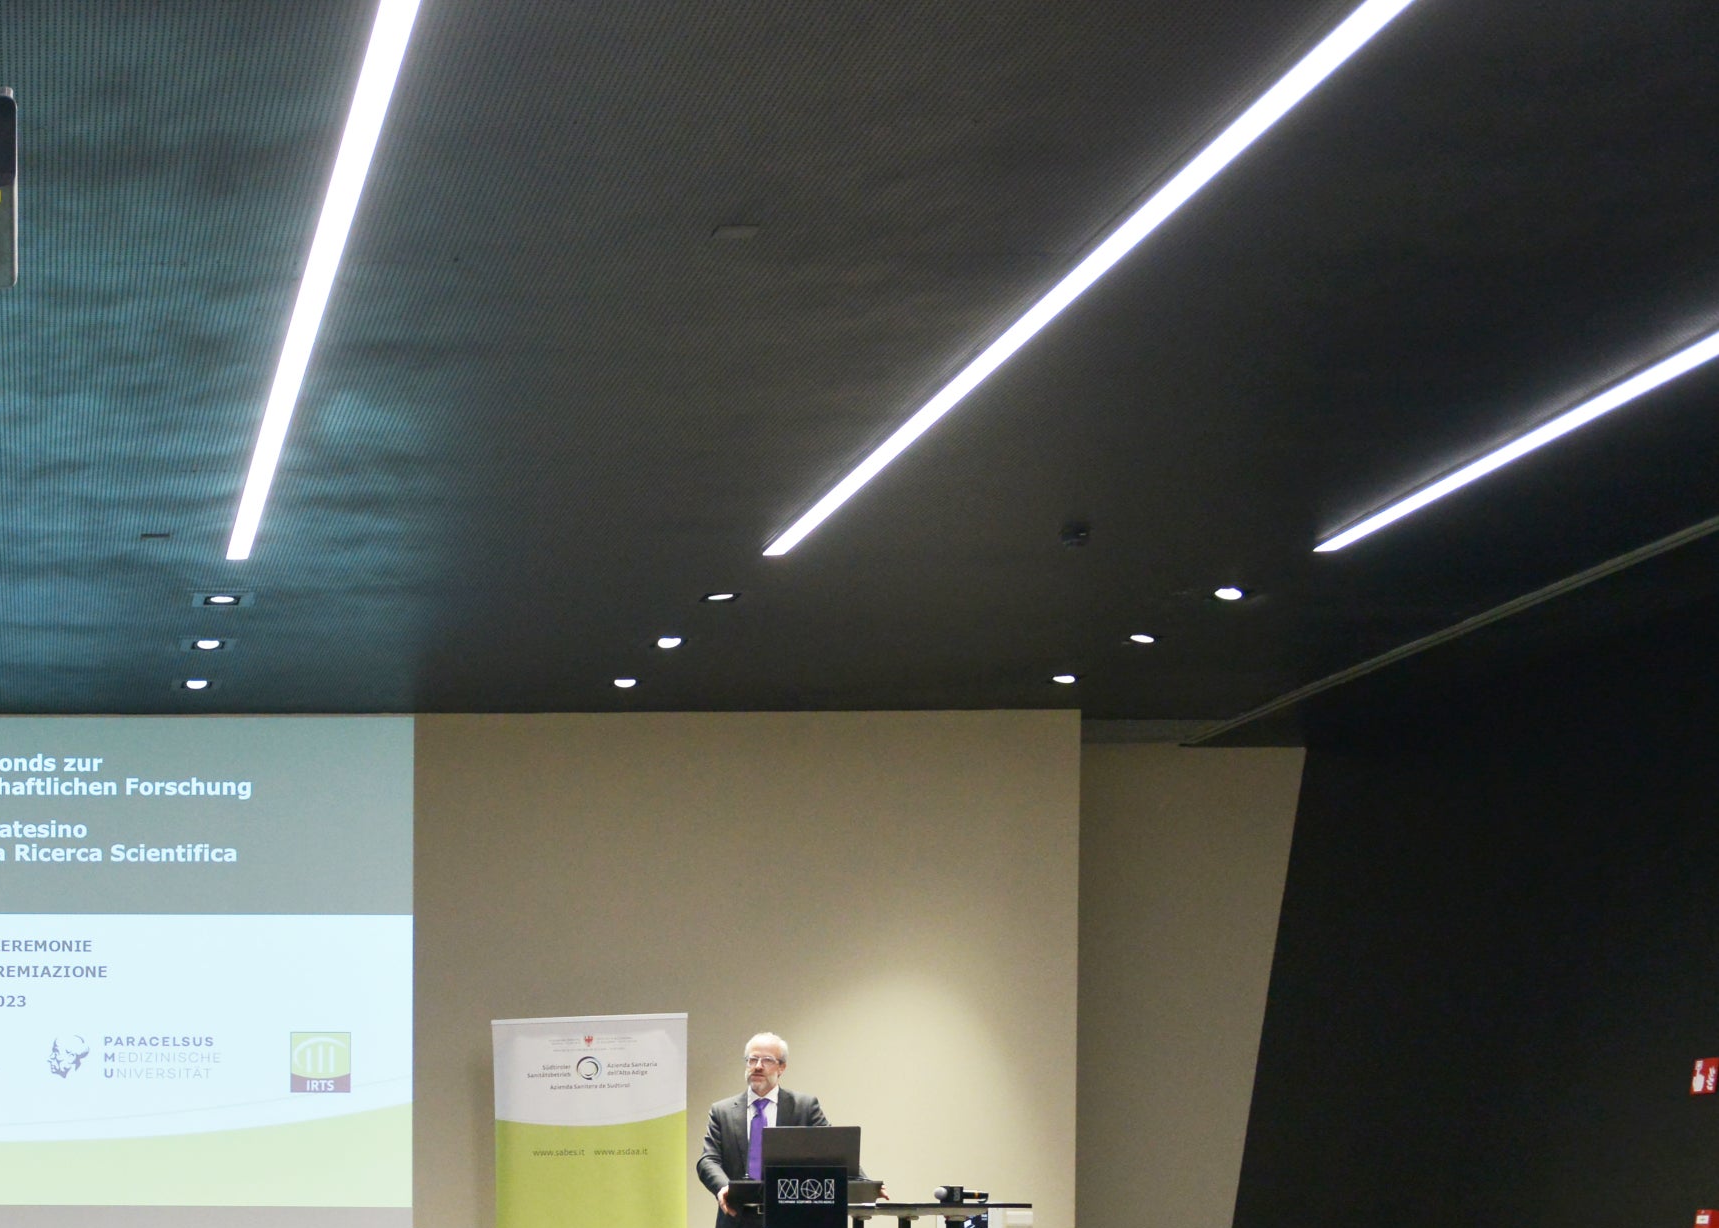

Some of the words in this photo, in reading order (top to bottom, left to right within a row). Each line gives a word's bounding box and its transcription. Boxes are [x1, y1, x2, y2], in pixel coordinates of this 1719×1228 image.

[63, 757, 104, 773] zur
[125, 776, 252, 800] Forschung
[14, 843, 103, 863] Ricerca
[110, 843, 237, 863] Scientifica
[103, 1036, 214, 1047] PARACELSUS
[103, 1051, 221, 1063] MEDIZINISCHE
[103, 1065, 212, 1079] UNIVERSITÄT
[306, 1079, 335, 1092] IRTS
[532, 1148, 586, 1158] www.sabes.it
[593, 1147, 649, 1157] www.asdaa.it
